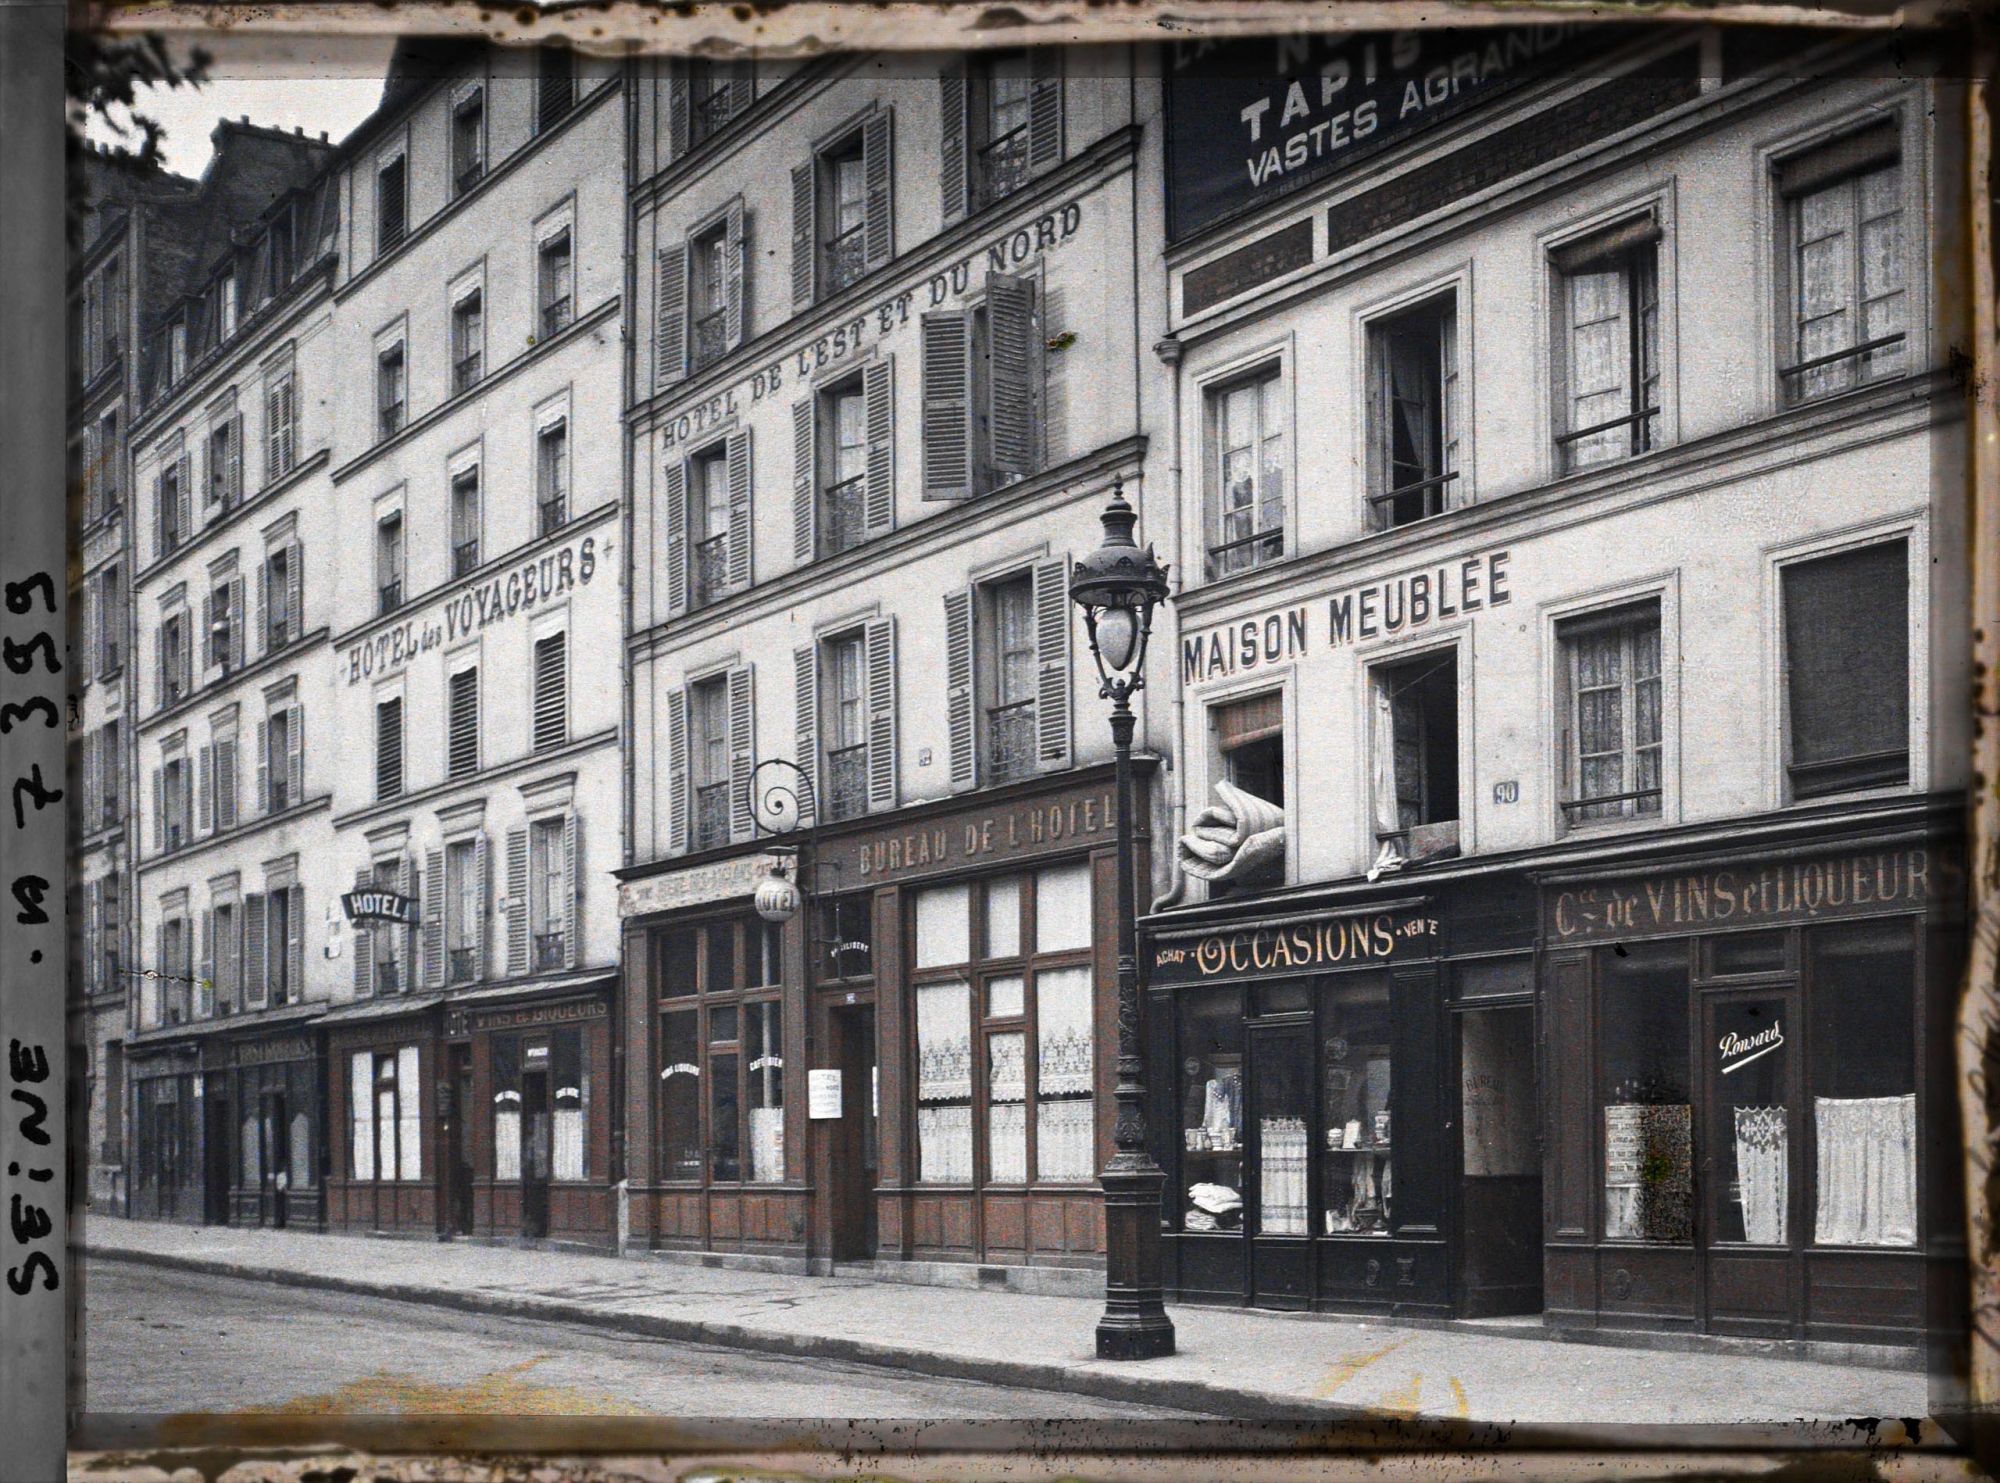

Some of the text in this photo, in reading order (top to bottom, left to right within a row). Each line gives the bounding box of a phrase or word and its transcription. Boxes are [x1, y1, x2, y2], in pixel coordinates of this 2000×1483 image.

[1241, 33, 1421, 142] TAPIS
[1247, 101, 1379, 187] VASTES
[1400, 24, 1588, 119] AGRANDI
[662, 394, 738, 450] HOTEL
[751, 362, 782, 401] DE
[878, 290, 914, 336] ET
[928, 261, 972, 306] DU
[986, 200, 1082, 275] NORD
[346, 536, 596, 685] HOTEL des VOYAGEURS
[1183, 606, 1308, 687] MAISON
[1496, 782, 1515, 804] 90
[859, 828, 947, 876] BUREAU
[964, 819, 995, 856] DE
[349, 892, 402, 918] HOTEL
[1645, 871, 1737, 925] VINS
[1744, 871, 1772, 916] et
[1155, 948, 1186, 967] ACHAT
[1196, 915, 1394, 976] OCCASIONS
